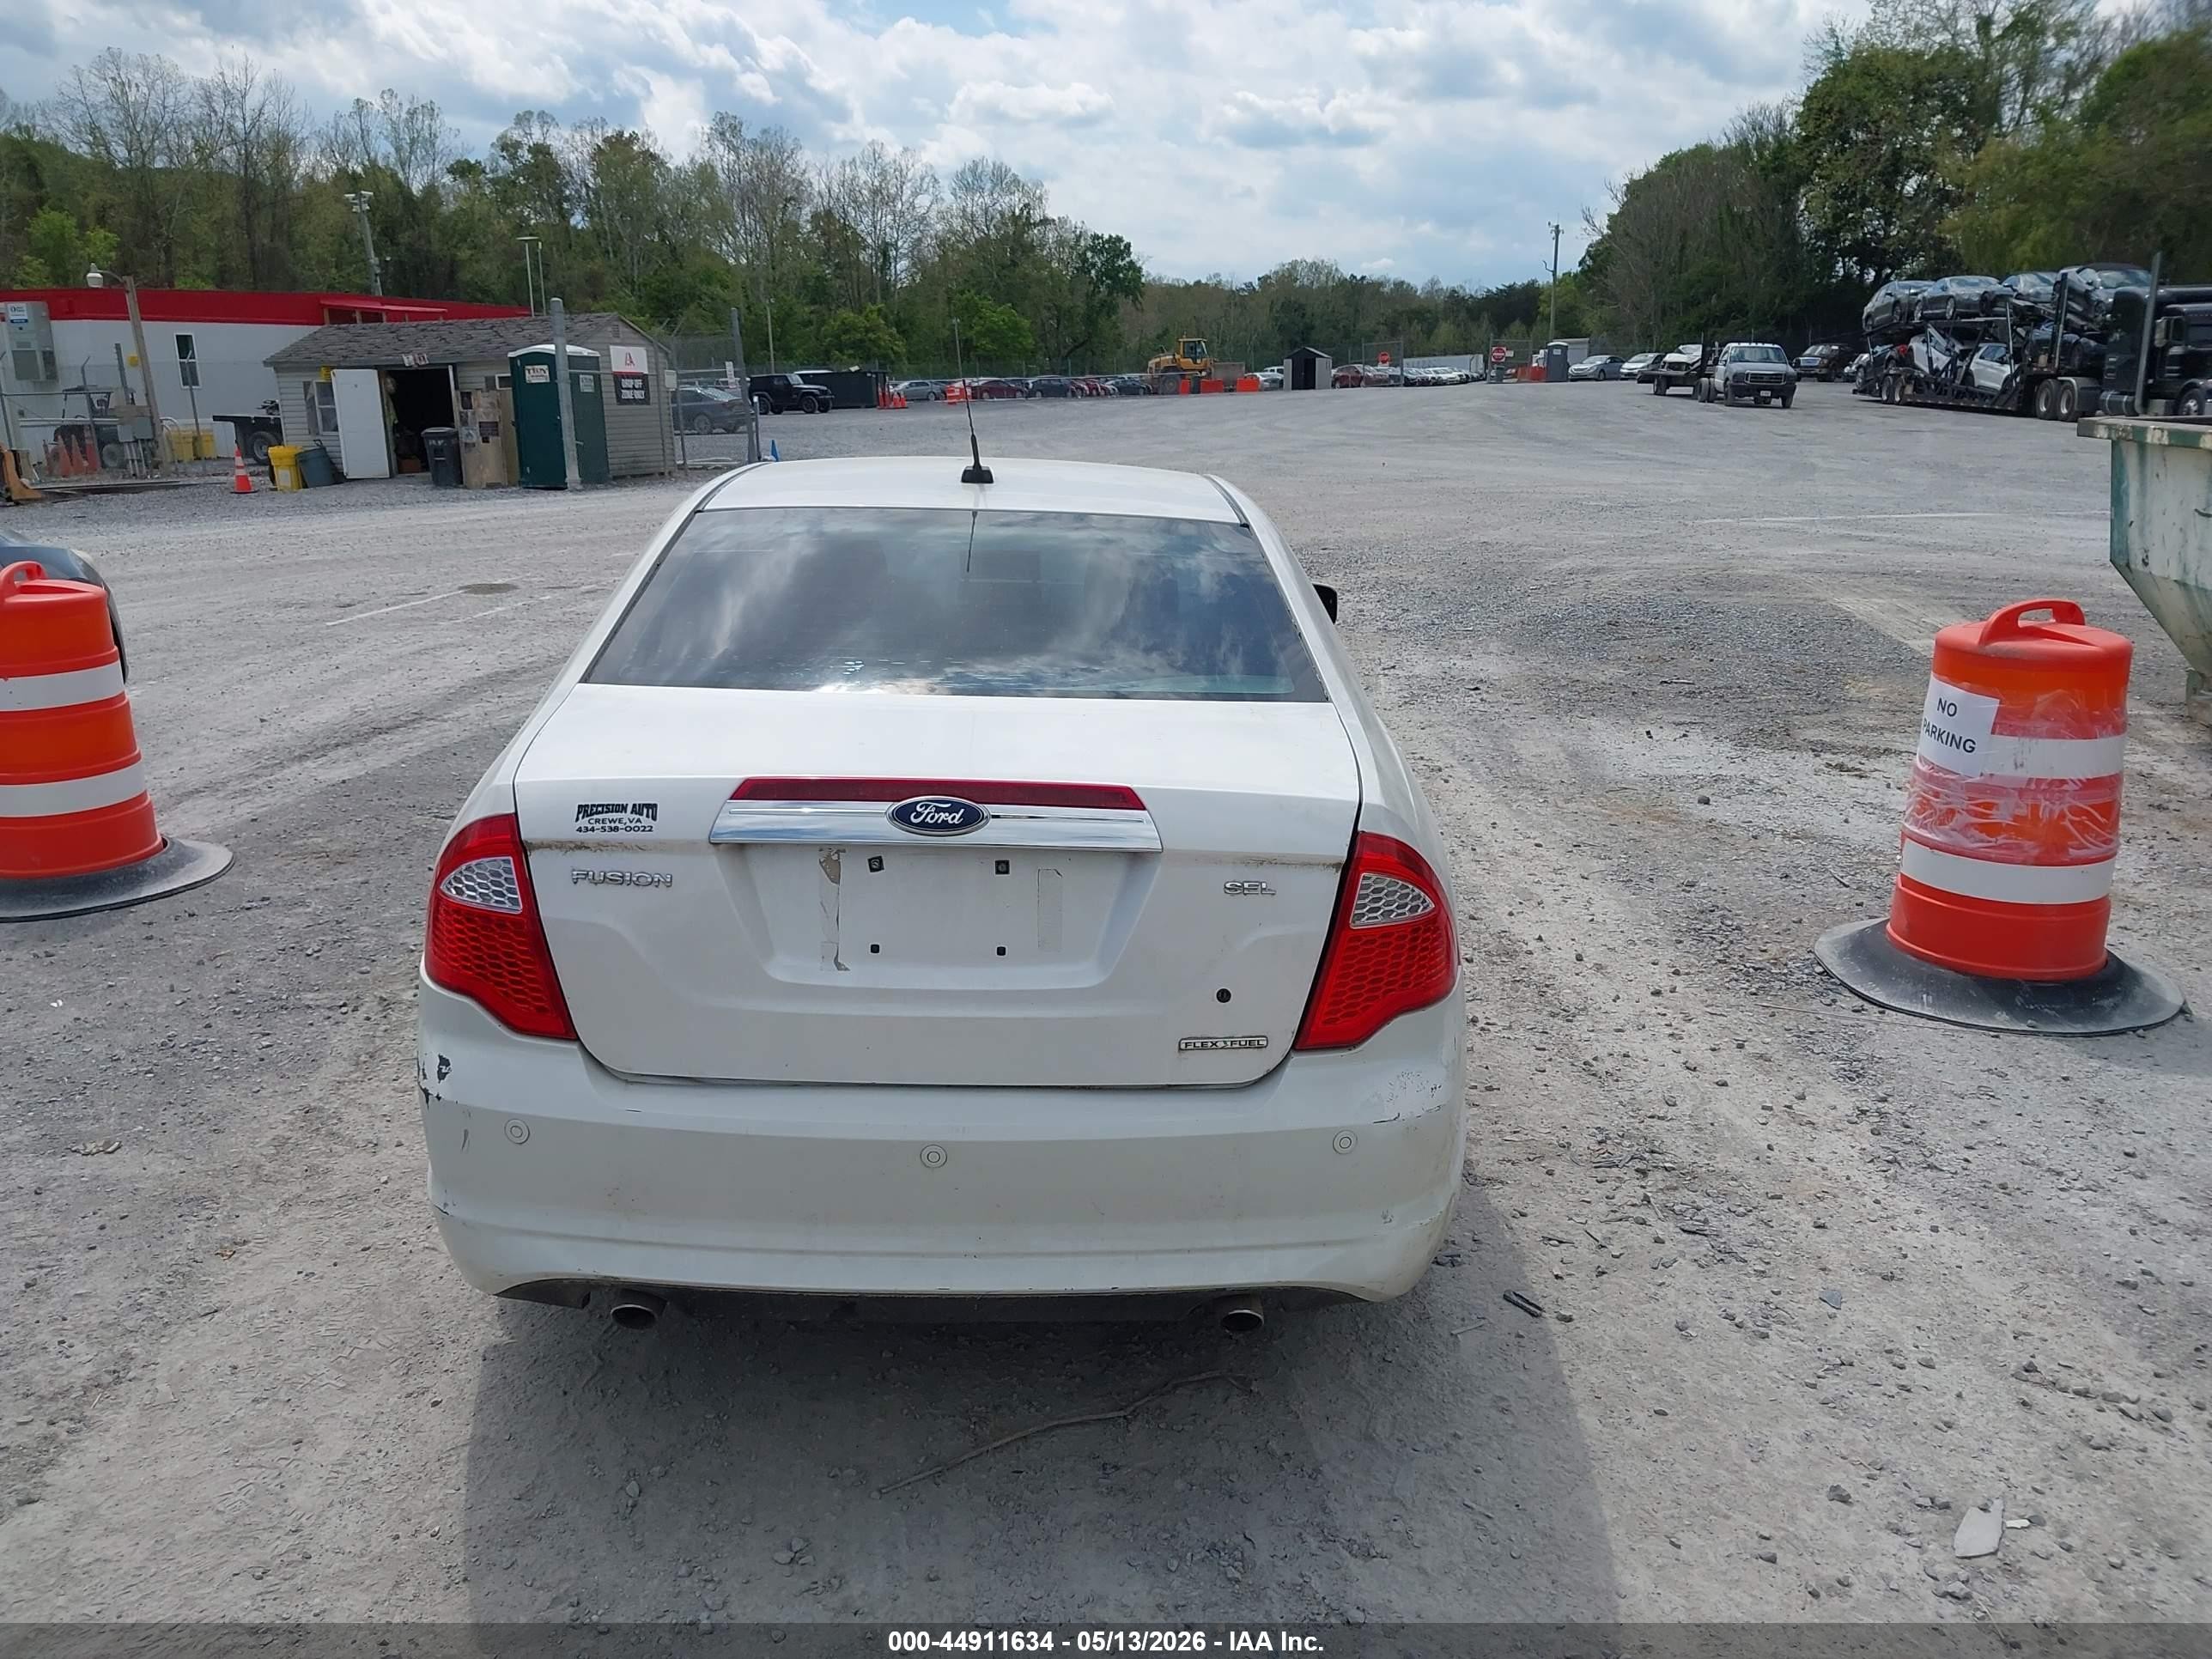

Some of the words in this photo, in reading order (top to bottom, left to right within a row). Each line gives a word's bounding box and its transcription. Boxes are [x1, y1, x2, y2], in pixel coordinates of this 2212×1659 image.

[1936, 697, 1958, 717] NO
[574, 803, 629, 823] PRECISION
[629, 803, 659, 822] AUTO
[910, 801, 965, 824] Ford
[571, 868, 673, 888] FUSION
[1224, 880, 1277, 896] SEL
